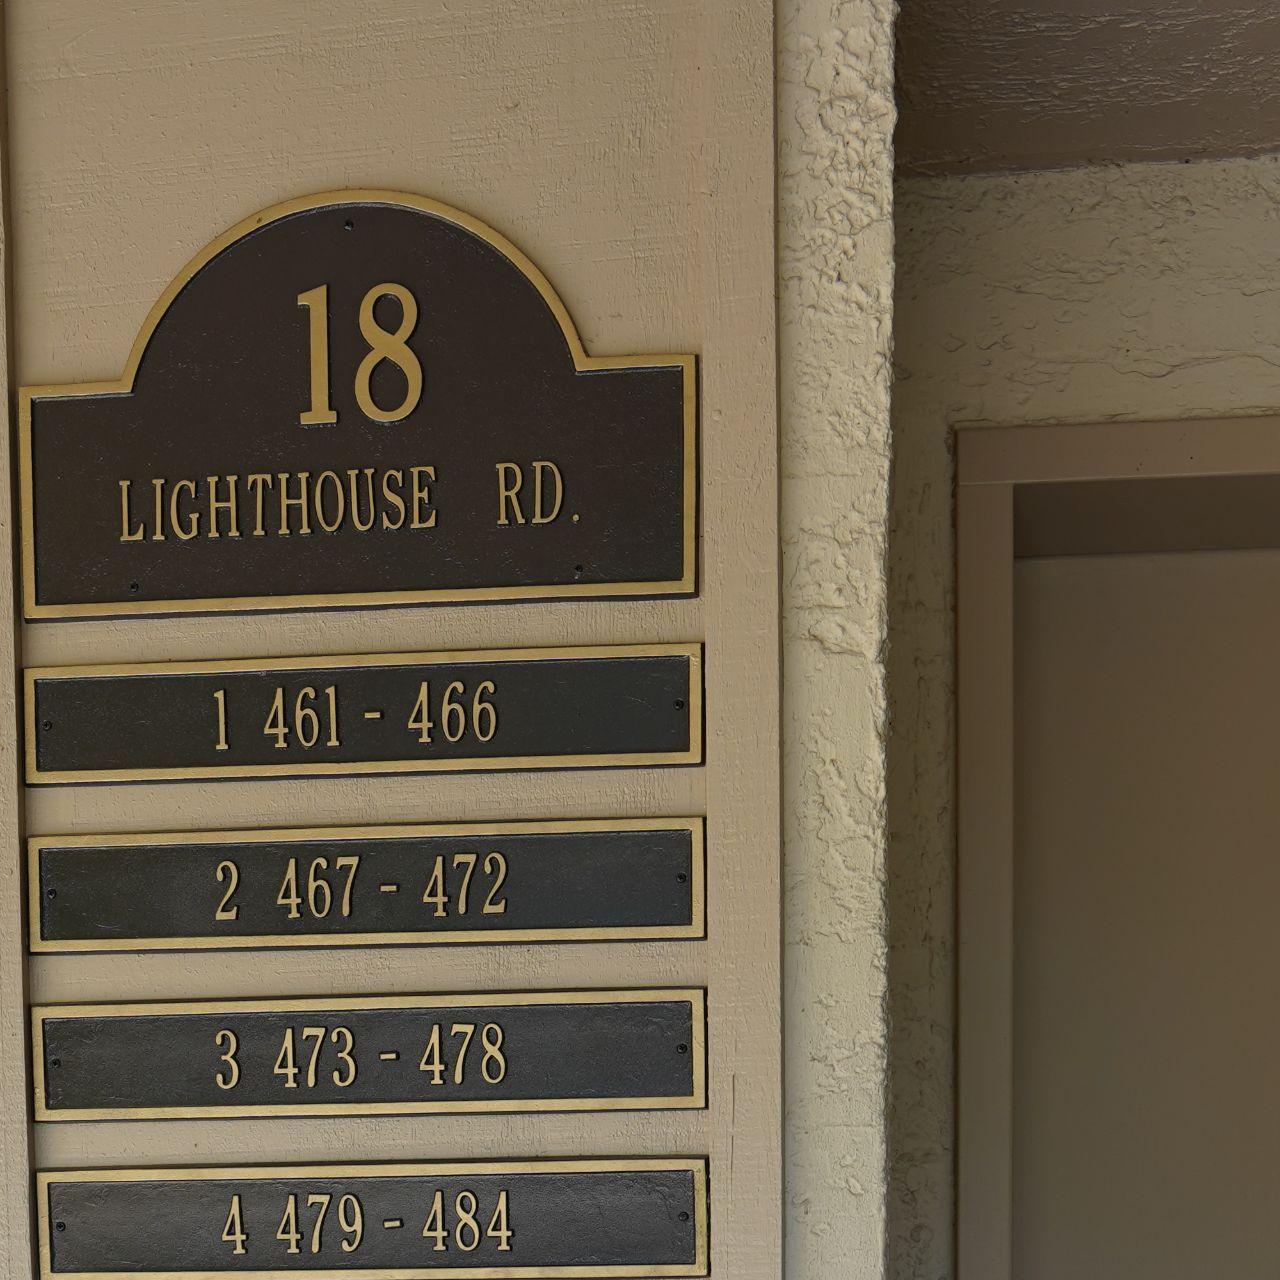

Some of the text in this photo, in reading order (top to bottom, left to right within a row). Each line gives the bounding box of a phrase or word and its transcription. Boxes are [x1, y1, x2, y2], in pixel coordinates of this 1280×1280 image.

[296, 283, 423, 426] 18
[119, 460, 581, 542] LIGHTHOUSE RD.
[213, 689, 229, 750] 1
[263, 684, 341, 749] 461
[407, 680, 498, 744] 466
[215, 860, 240, 921] 2
[276, 855, 360, 919] 467
[422, 852, 508, 917] 472
[215, 1029, 241, 1090] 3
[274, 1025, 358, 1089] 473
[419, 1022, 508, 1086] 478
[221, 1195, 247, 1254] 4
[276, 1193, 364, 1254] 479
[422, 1190, 513, 1252] 484
